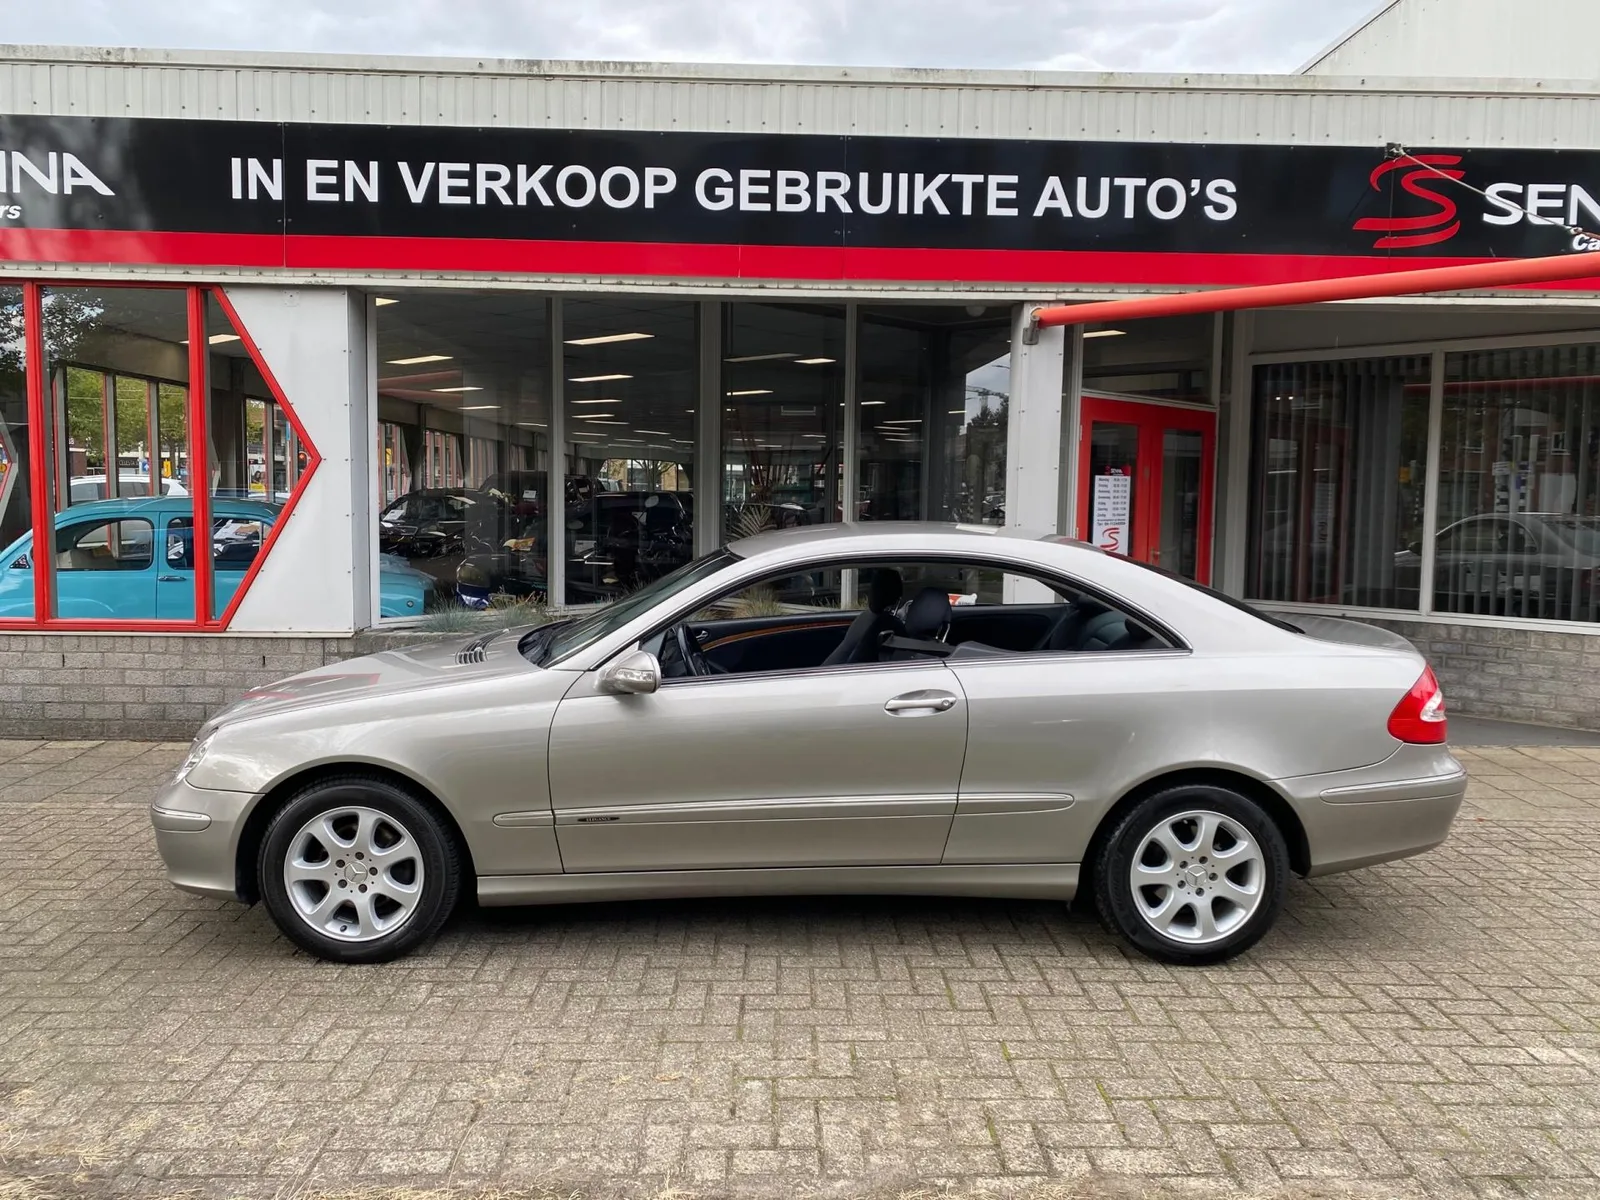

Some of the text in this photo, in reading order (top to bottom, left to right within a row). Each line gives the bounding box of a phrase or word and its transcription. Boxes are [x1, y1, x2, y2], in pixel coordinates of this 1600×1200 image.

[0, 151, 116, 196] NA
[231, 157, 1238, 221] IN EN VERKOOP GEBRUIKTE AUTO'S
